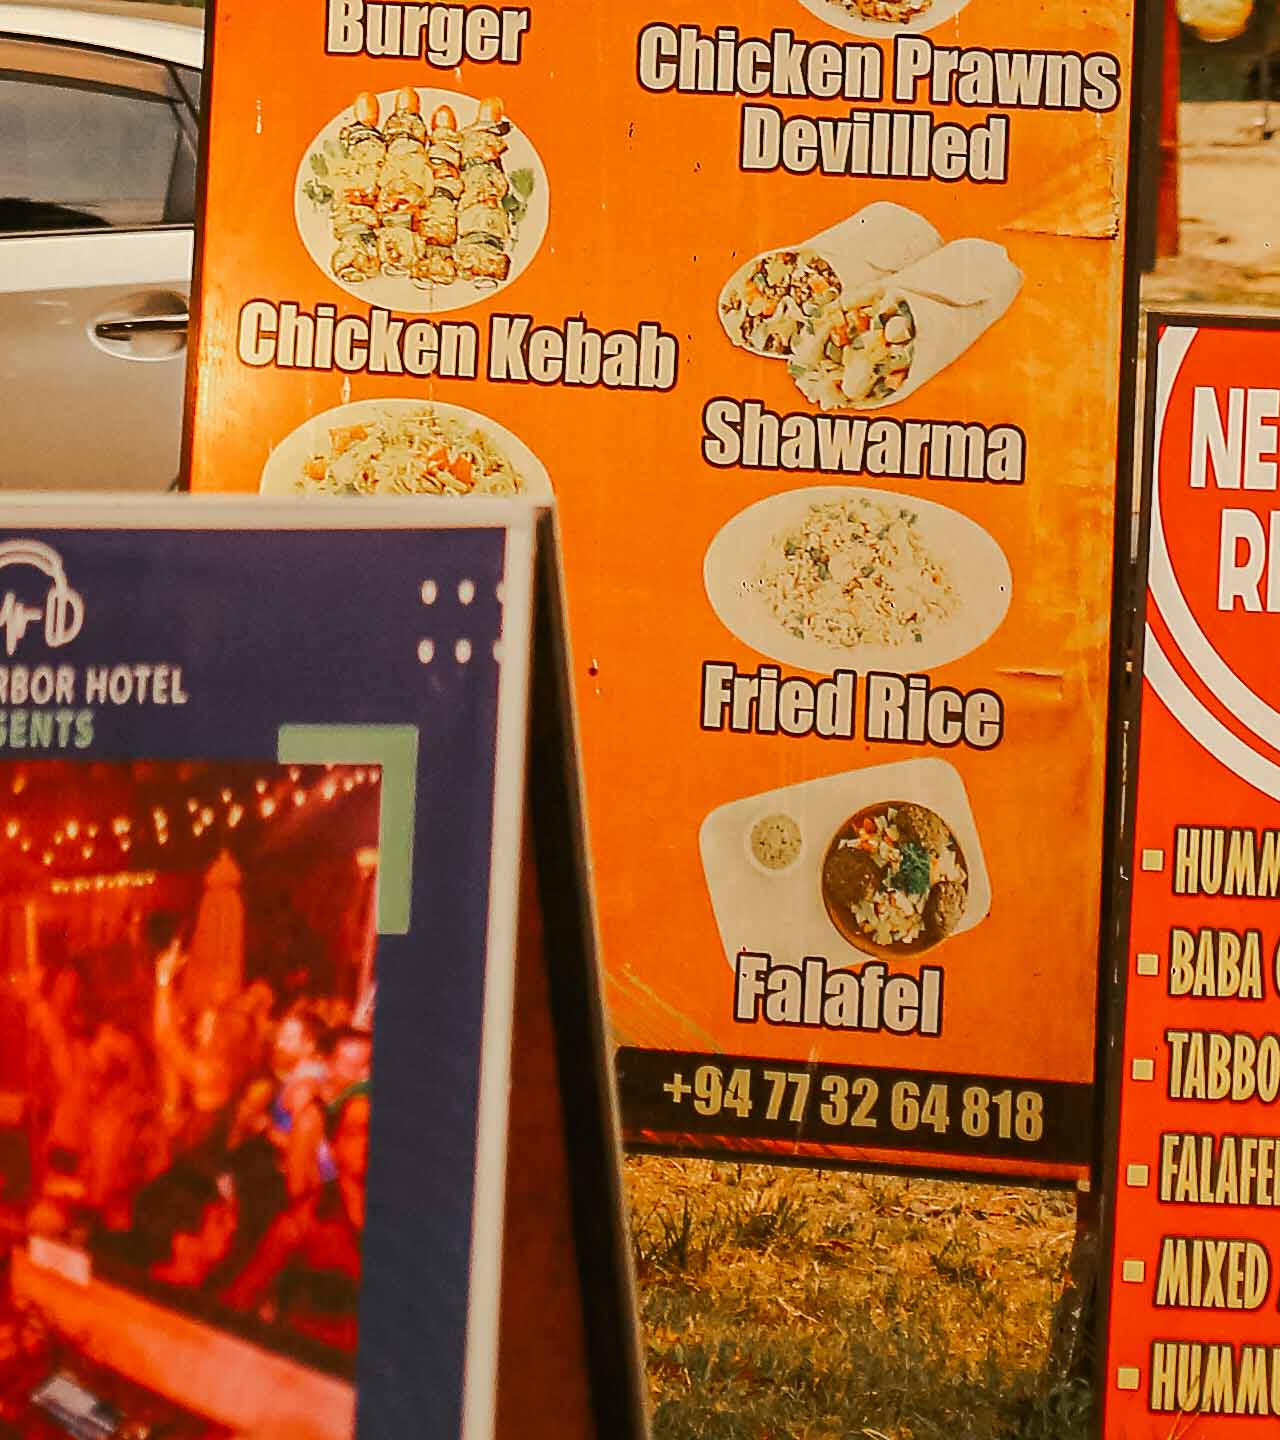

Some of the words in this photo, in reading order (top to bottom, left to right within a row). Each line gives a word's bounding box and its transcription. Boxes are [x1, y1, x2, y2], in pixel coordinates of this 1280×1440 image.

[640, 26, 880, 98] Chicken
[896, 38, 1117, 109] Prawns
[240, 302, 475, 377] Chicken
[490, 317, 675, 388] Kebab
[705, 401, 1022, 480] Shawarma
[84, 666, 187, 706] HOTEL
[704, 665, 853, 736] Fried
[868, 675, 999, 746] Rice
[738, 956, 939, 1033] Falafel
[1171, 930, 1262, 998] BABA
[664, 1066, 752, 1117] +94
[764, 1071, 810, 1122] 77
[821, 1075, 878, 1127] 32
[892, 1081, 949, 1132] 64
[962, 1085, 1044, 1141] 818
[1157, 1239, 1268, 1308] MIXED
